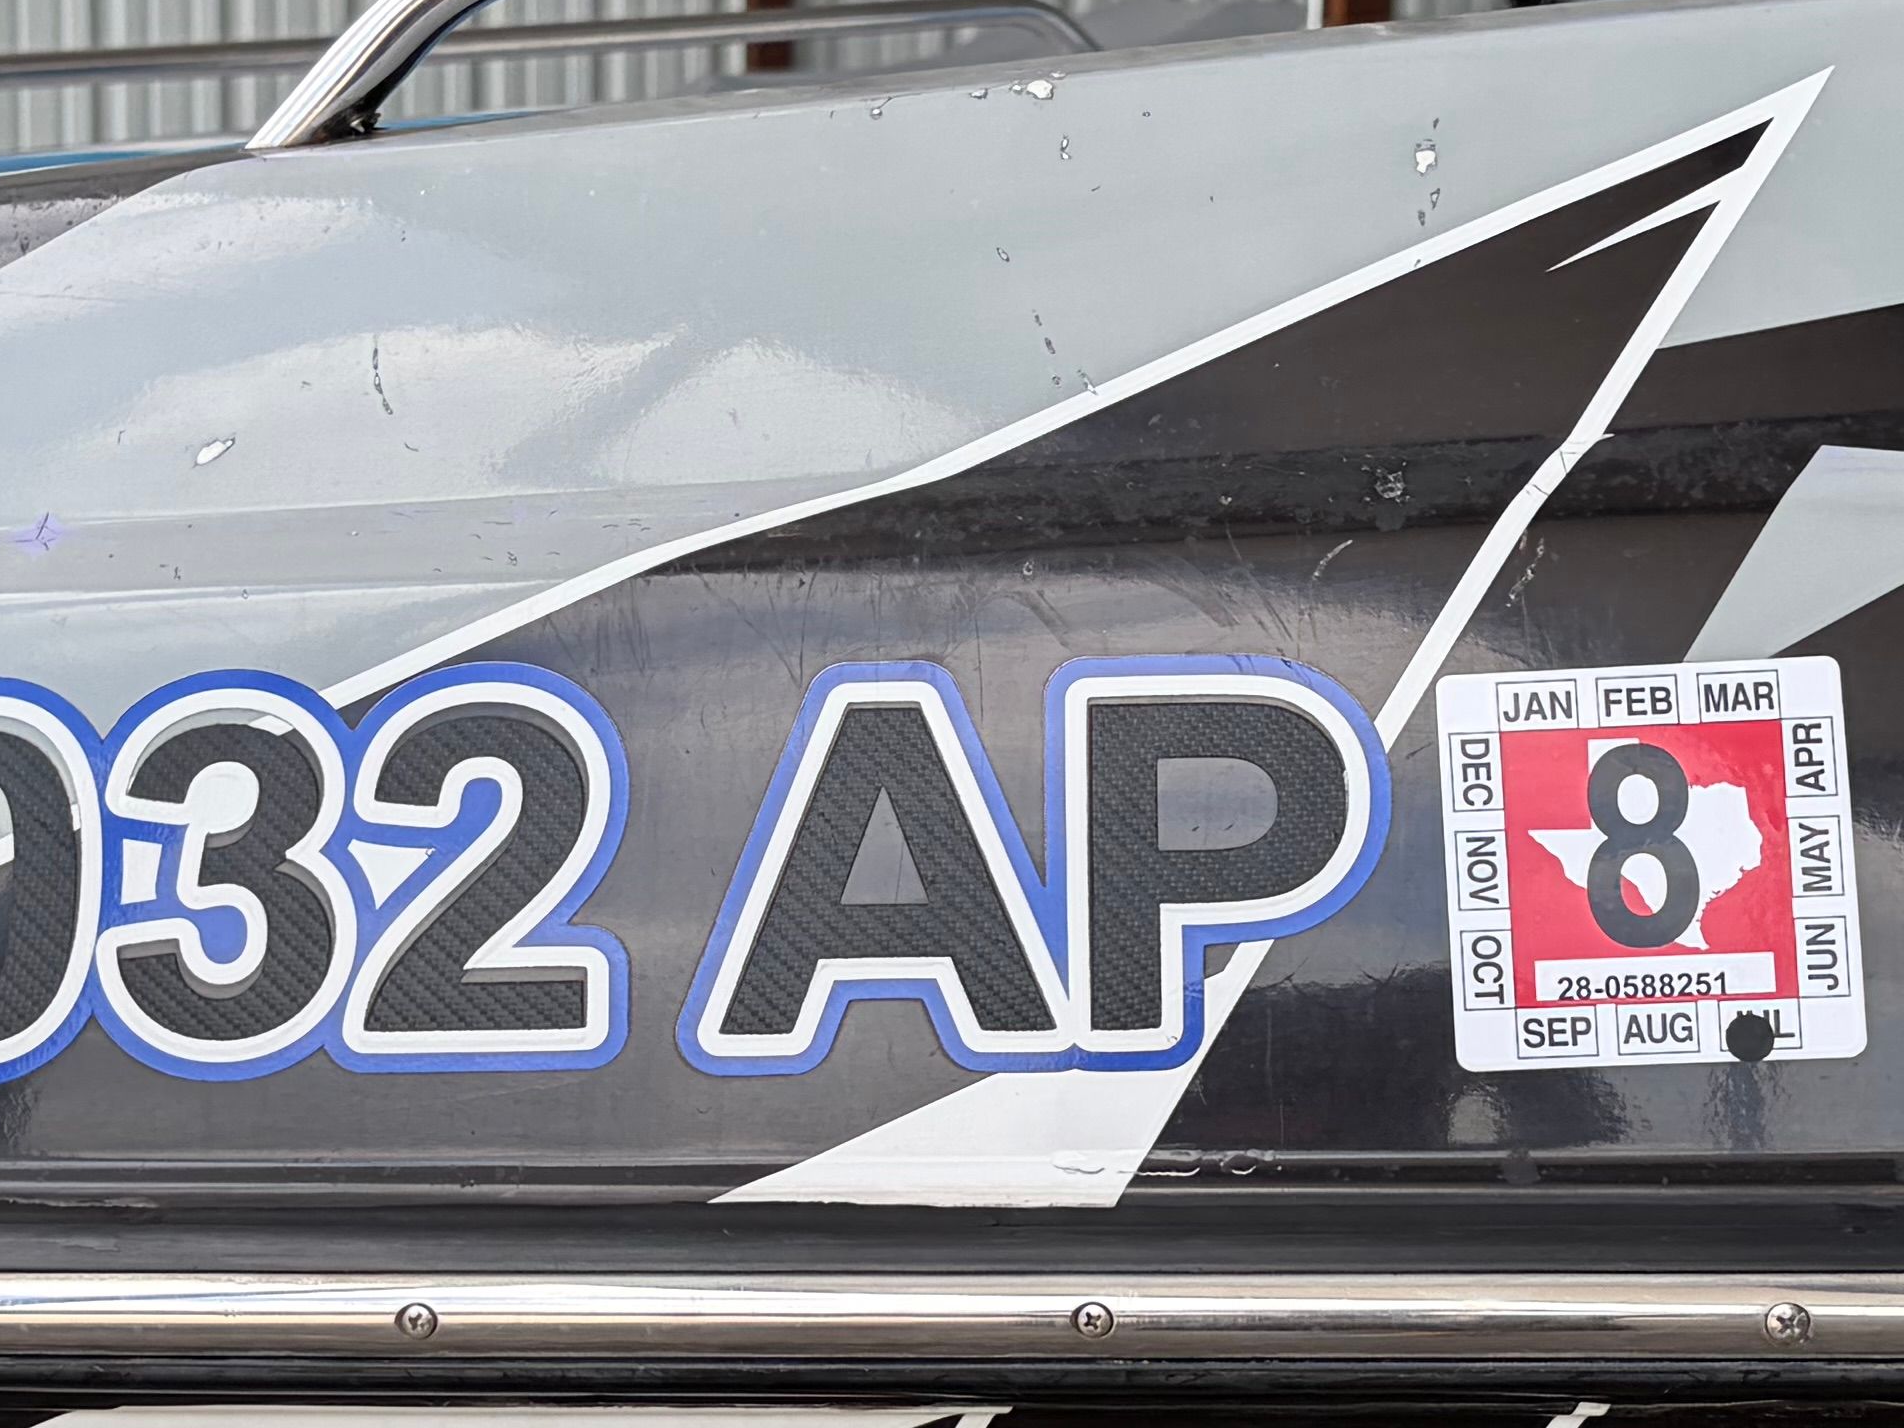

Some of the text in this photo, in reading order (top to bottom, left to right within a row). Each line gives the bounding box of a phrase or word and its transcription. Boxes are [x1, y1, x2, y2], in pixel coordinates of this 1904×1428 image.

[1503, 681, 1775, 722] JAN FEB MAR
[1459, 738, 1493, 807] DEC
[1792, 721, 1826, 792] APR
[696, 674, 1371, 1058] AP
[1465, 836, 1499, 905] NOV
[1587, 743, 1700, 948] 8
[1799, 822, 1833, 893] MAY
[1471, 935, 1505, 1005] OCT
[1557, 972, 1729, 1001] 28-0588251
[1805, 923, 1839, 992] JUN
[1523, 1016, 1592, 1049] SEP
[1623, 1012, 1694, 1046] AUG
